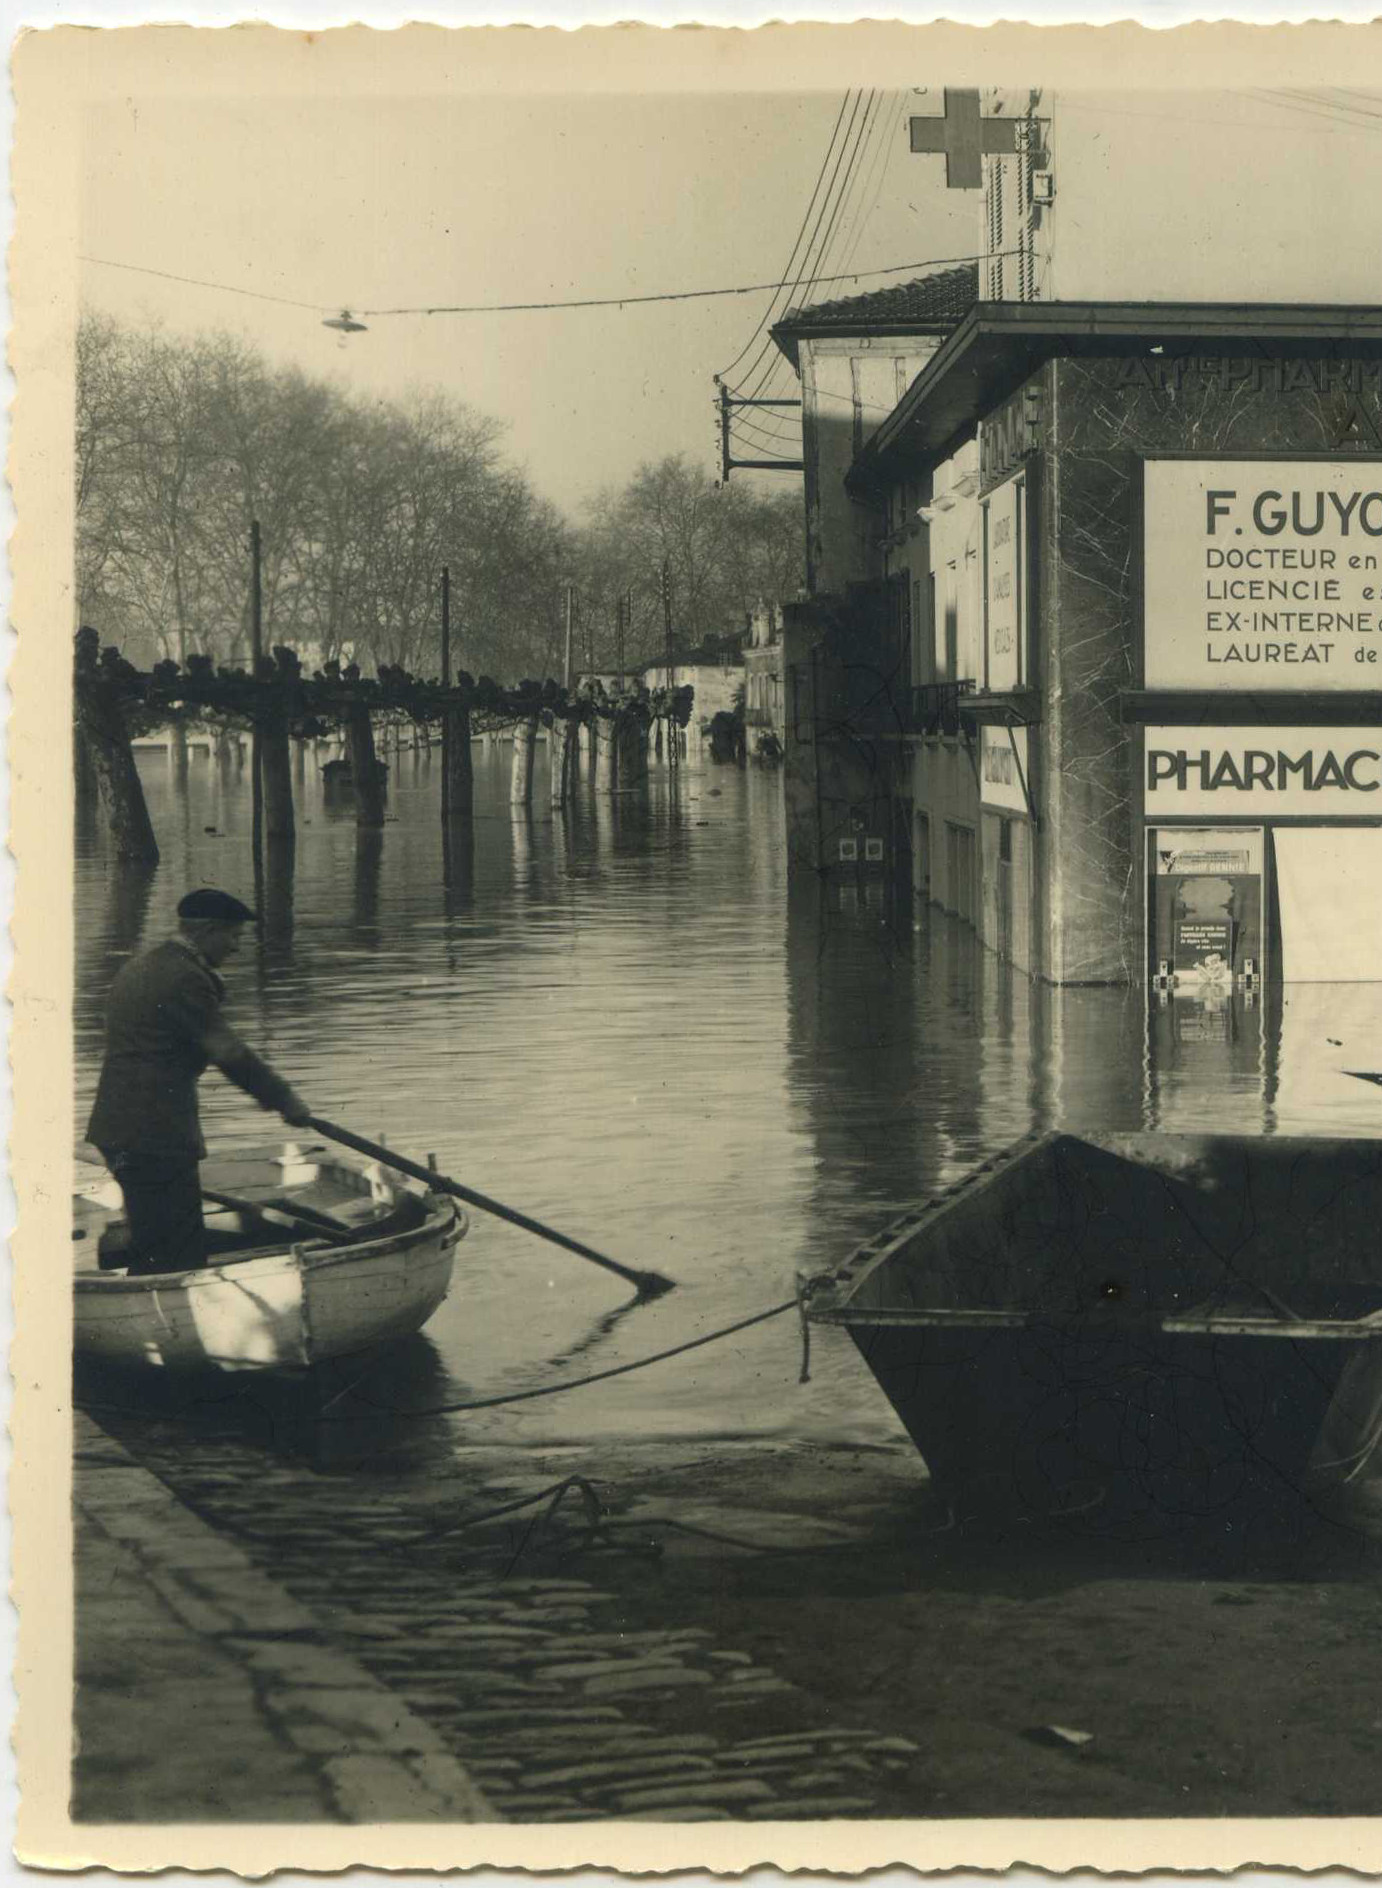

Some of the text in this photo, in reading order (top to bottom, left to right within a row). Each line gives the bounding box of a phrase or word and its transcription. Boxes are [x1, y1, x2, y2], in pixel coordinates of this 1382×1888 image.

[1206, 548, 1337, 571] DOCTEUR
[1348, 555, 1377, 570] en
[1207, 611, 1373, 633] EX-INTERNE
[1354, 646, 1378, 664] de
